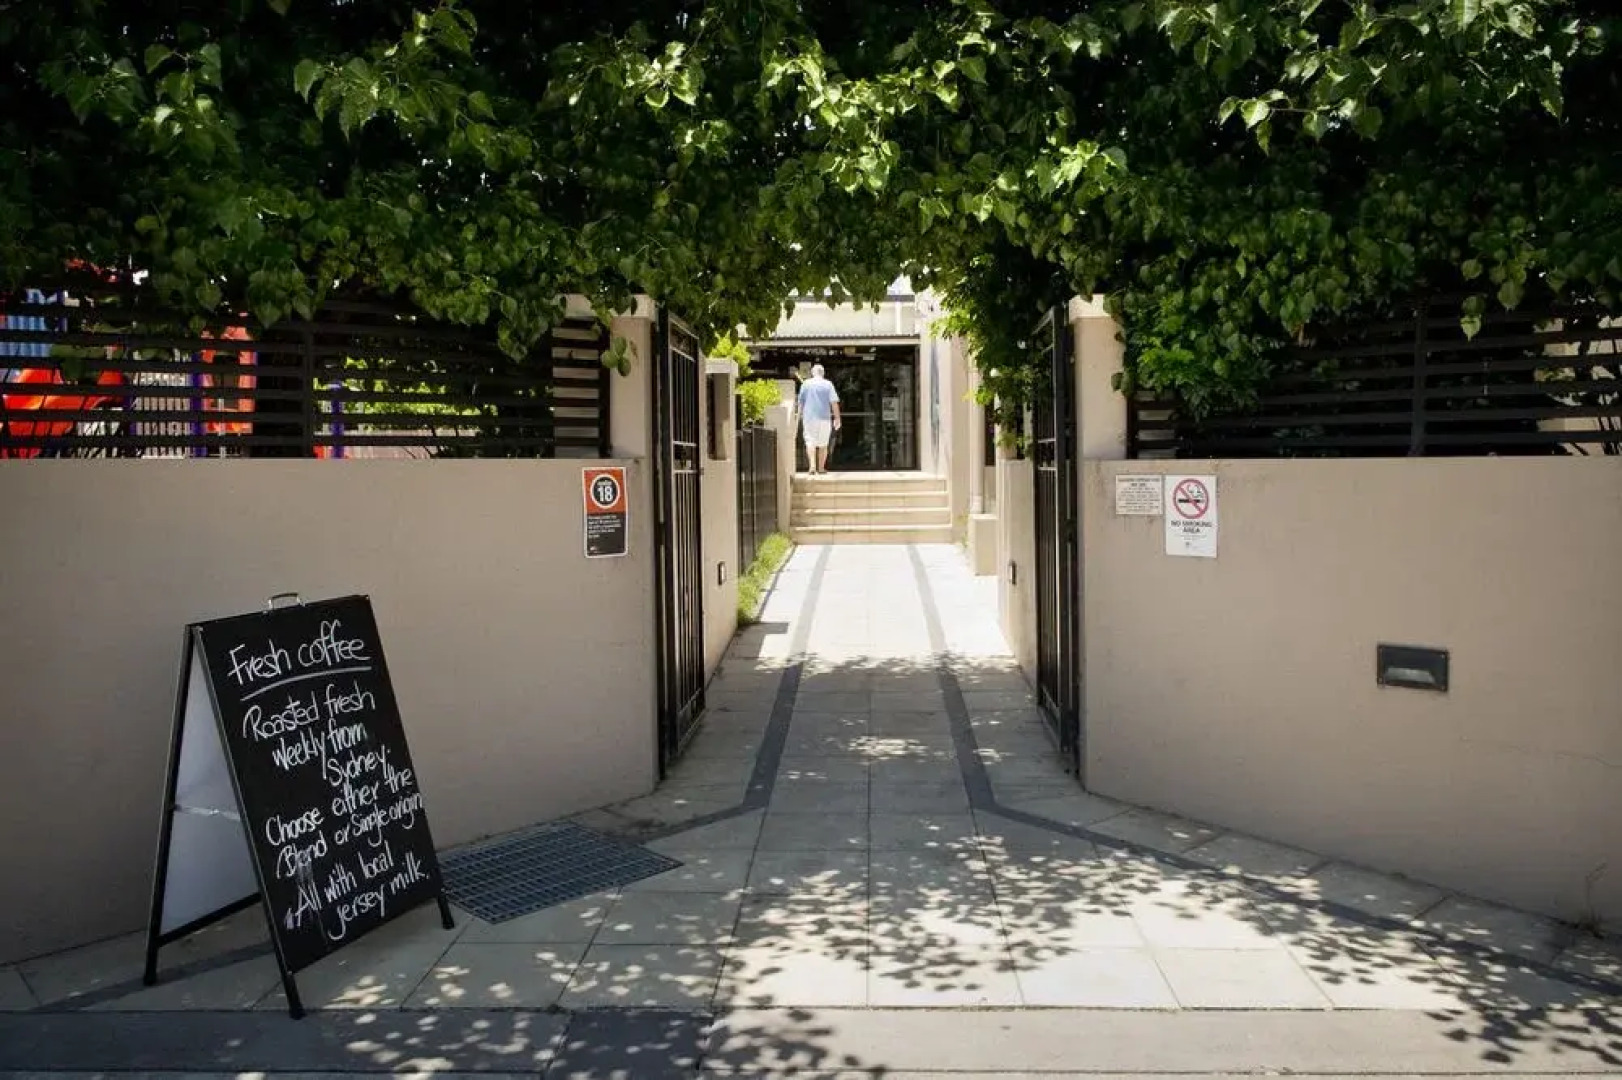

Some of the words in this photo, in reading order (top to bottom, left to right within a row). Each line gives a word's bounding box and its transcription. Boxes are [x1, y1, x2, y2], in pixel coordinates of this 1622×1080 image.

[597, 486, 613, 502] 18
[227, 639, 292, 685] Fresh
[298, 619, 371, 666] coffee
[242, 689, 320, 742] Roasted
[324, 679, 376, 718] fresh
[327, 718, 369, 755] from
[266, 807, 325, 846] Choose
[332, 781, 381, 816] either
[385, 763, 413, 793] the
[276, 830, 328, 879] Blend
[334, 823, 350, 846] or
[389, 791, 423, 829] origin
[293, 881, 323, 927] All
[324, 863, 358, 903] with
[358, 839, 395, 879] local
